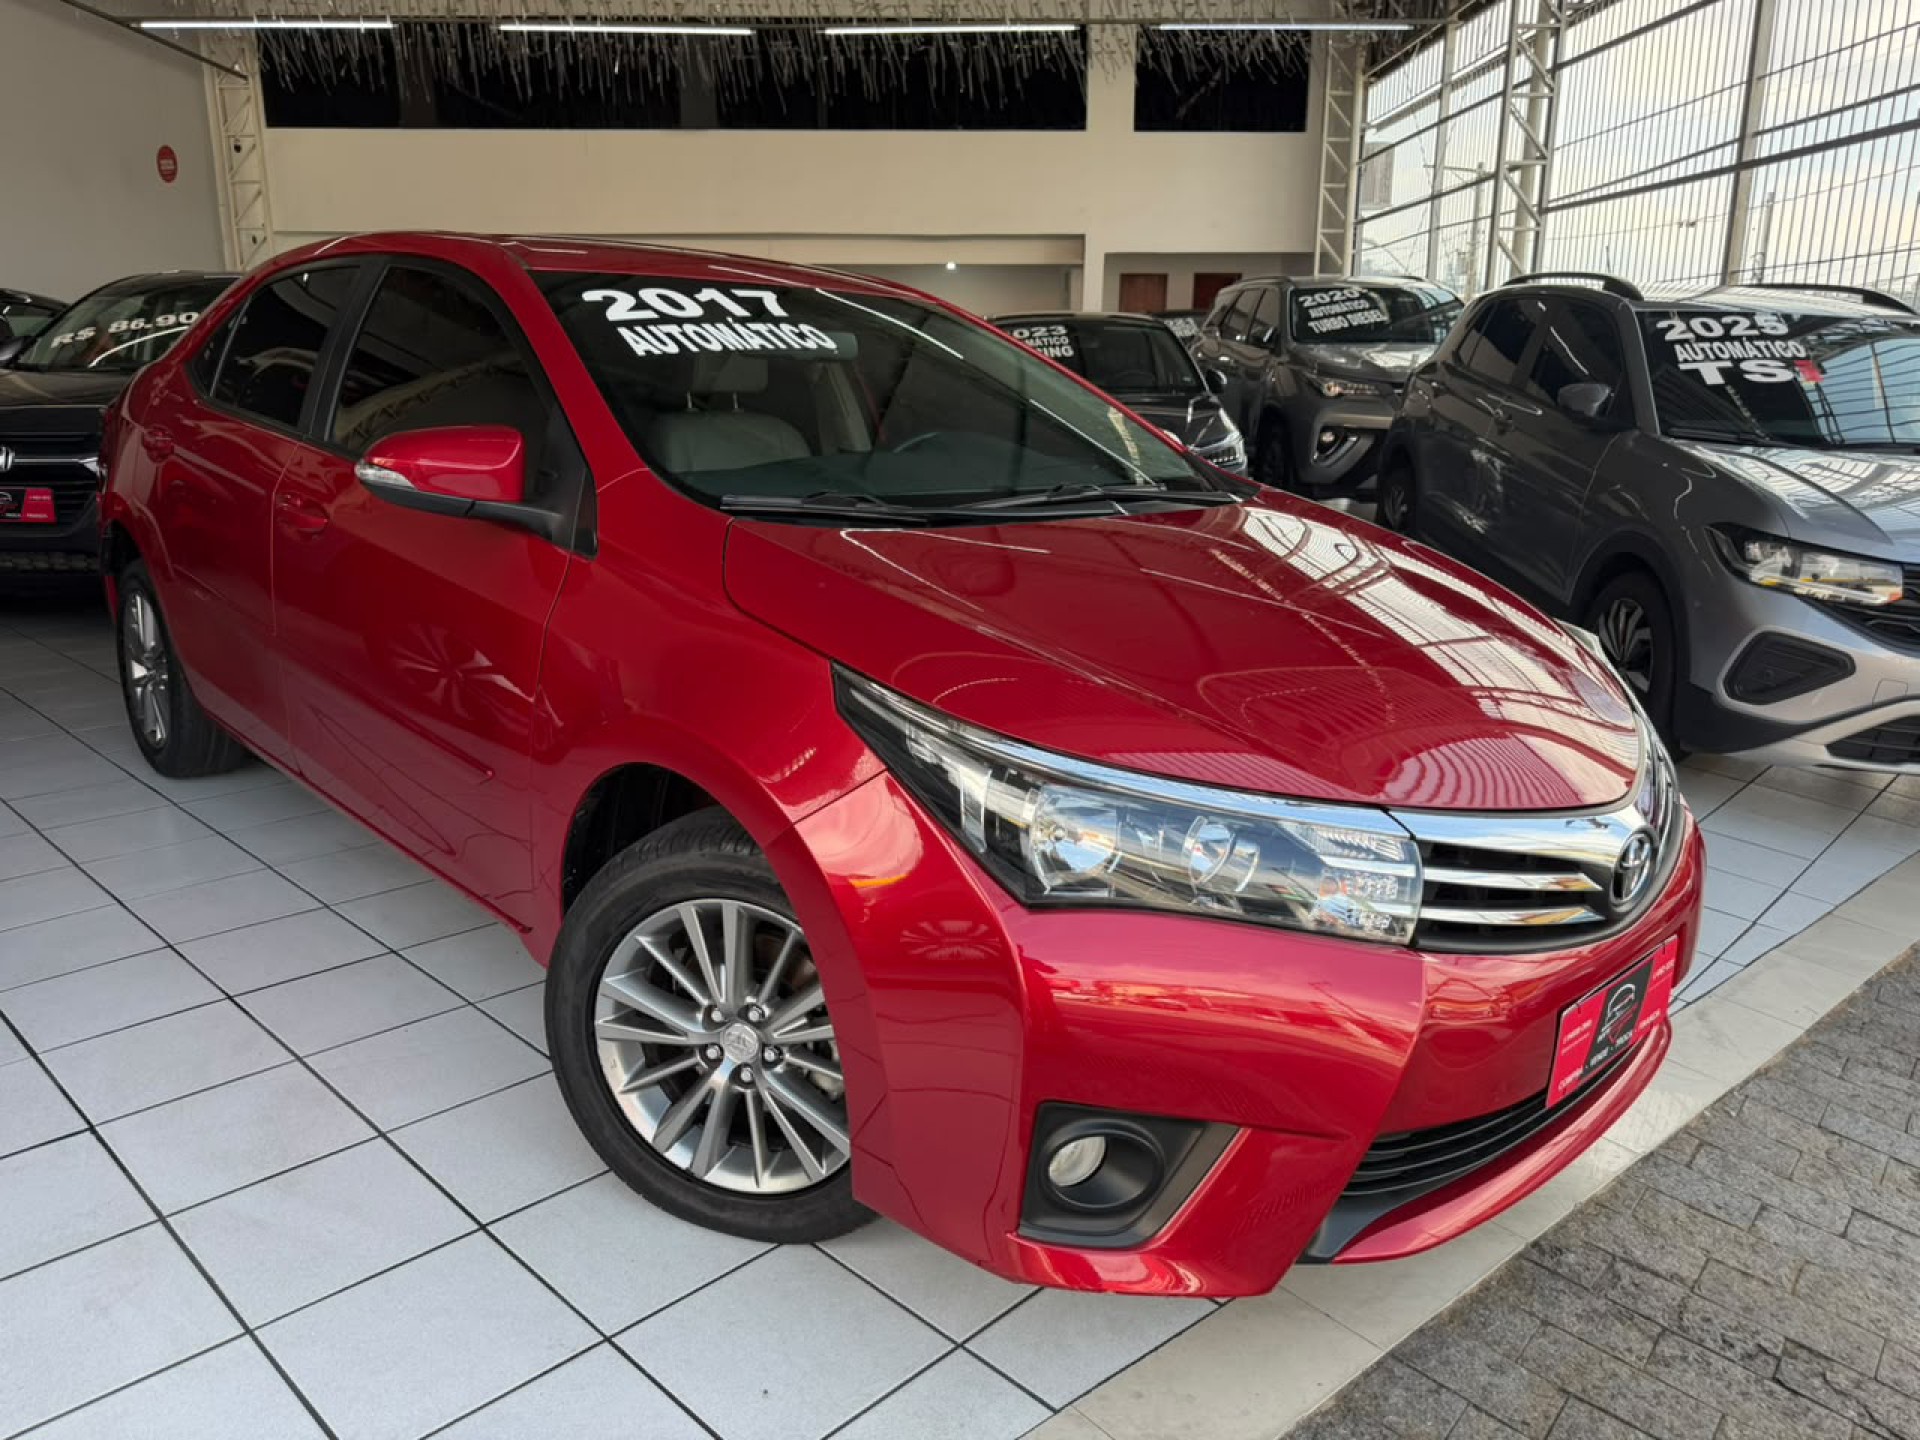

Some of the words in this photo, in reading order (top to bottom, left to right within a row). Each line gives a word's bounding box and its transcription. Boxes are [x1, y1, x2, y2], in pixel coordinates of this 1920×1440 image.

[582, 287, 789, 321] 2017
[617, 317, 838, 357] AUTOMÁTICO
[1008, 325, 1068, 339] 023
[1308, 315, 1349, 334] TURBO
[1656, 314, 1789, 341] 2025
[1674, 336, 1807, 361] AUTOMÁTICO
